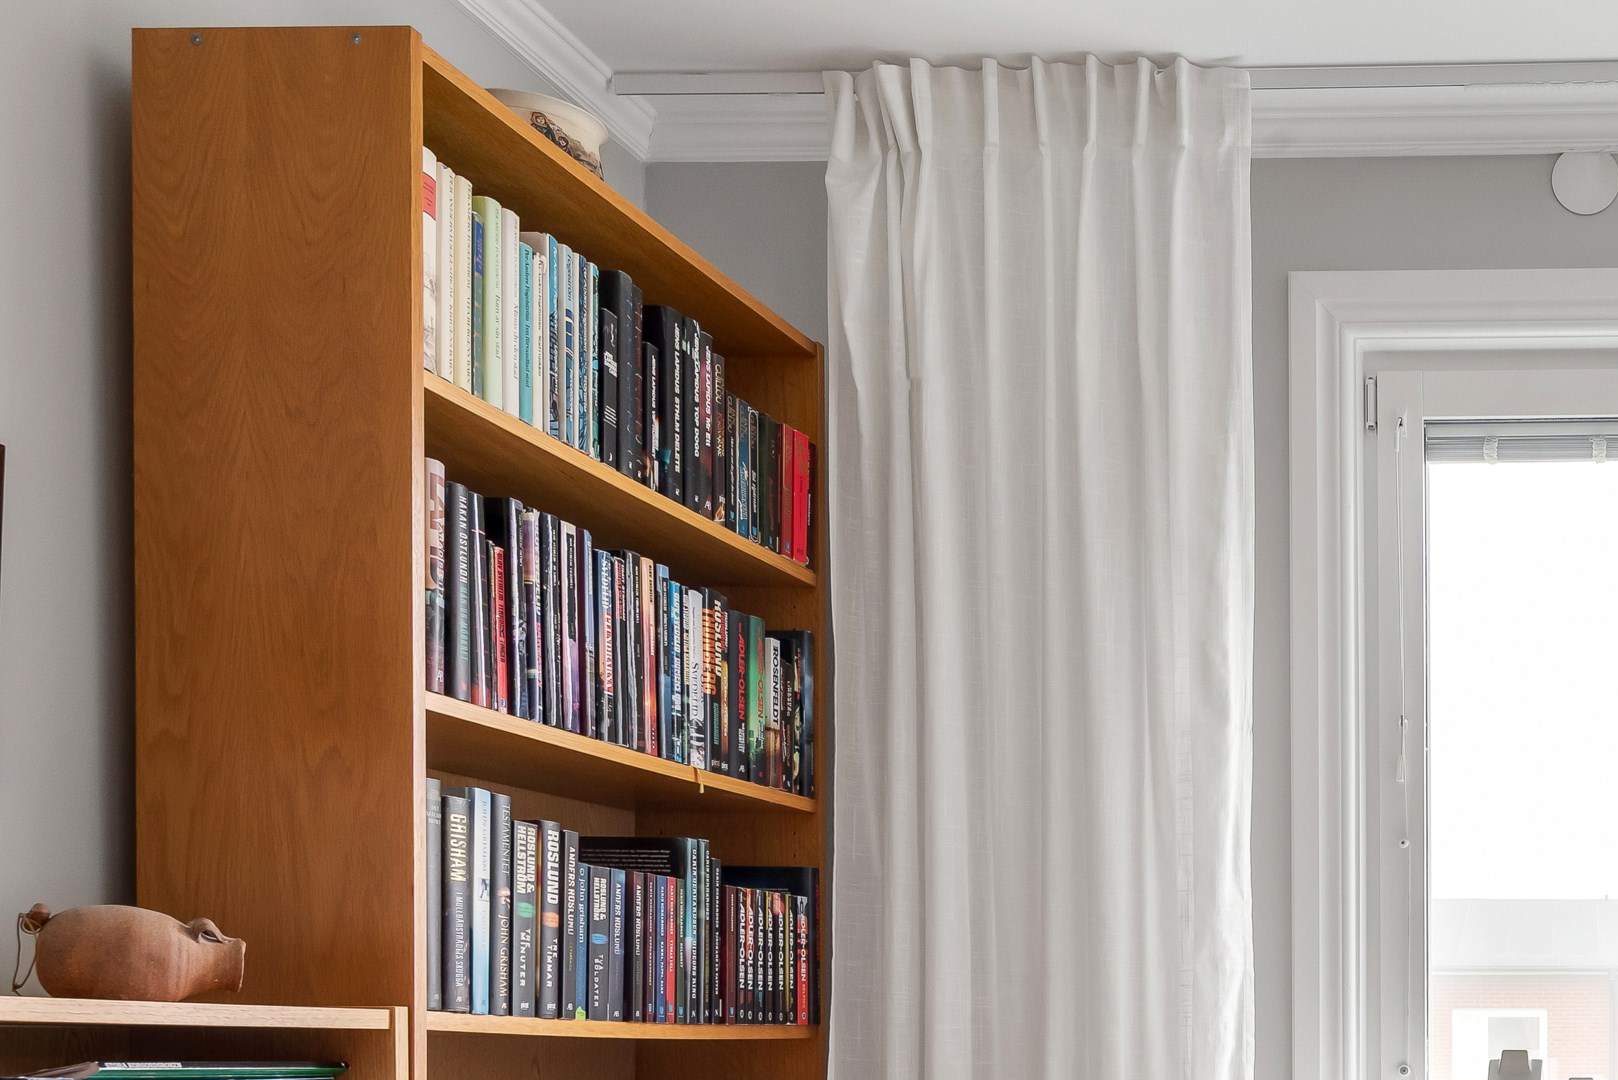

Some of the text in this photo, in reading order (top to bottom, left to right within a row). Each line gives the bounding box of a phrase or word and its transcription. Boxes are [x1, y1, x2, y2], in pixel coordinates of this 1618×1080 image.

[706, 418, 711, 431] Mr
[703, 608, 716, 695] THUNBERG
[450, 813, 466, 882] GRISHAM
[502, 804, 510, 876] TESTAMENTET
[517, 826, 527, 894] HELLSTRÖM
[527, 828, 535, 893] ROSLUND &
[547, 830, 559, 904] ROSLUND
[593, 877, 601, 921] HELLSTRÖM
[498, 914, 509, 997] JOHN GRISHAM
